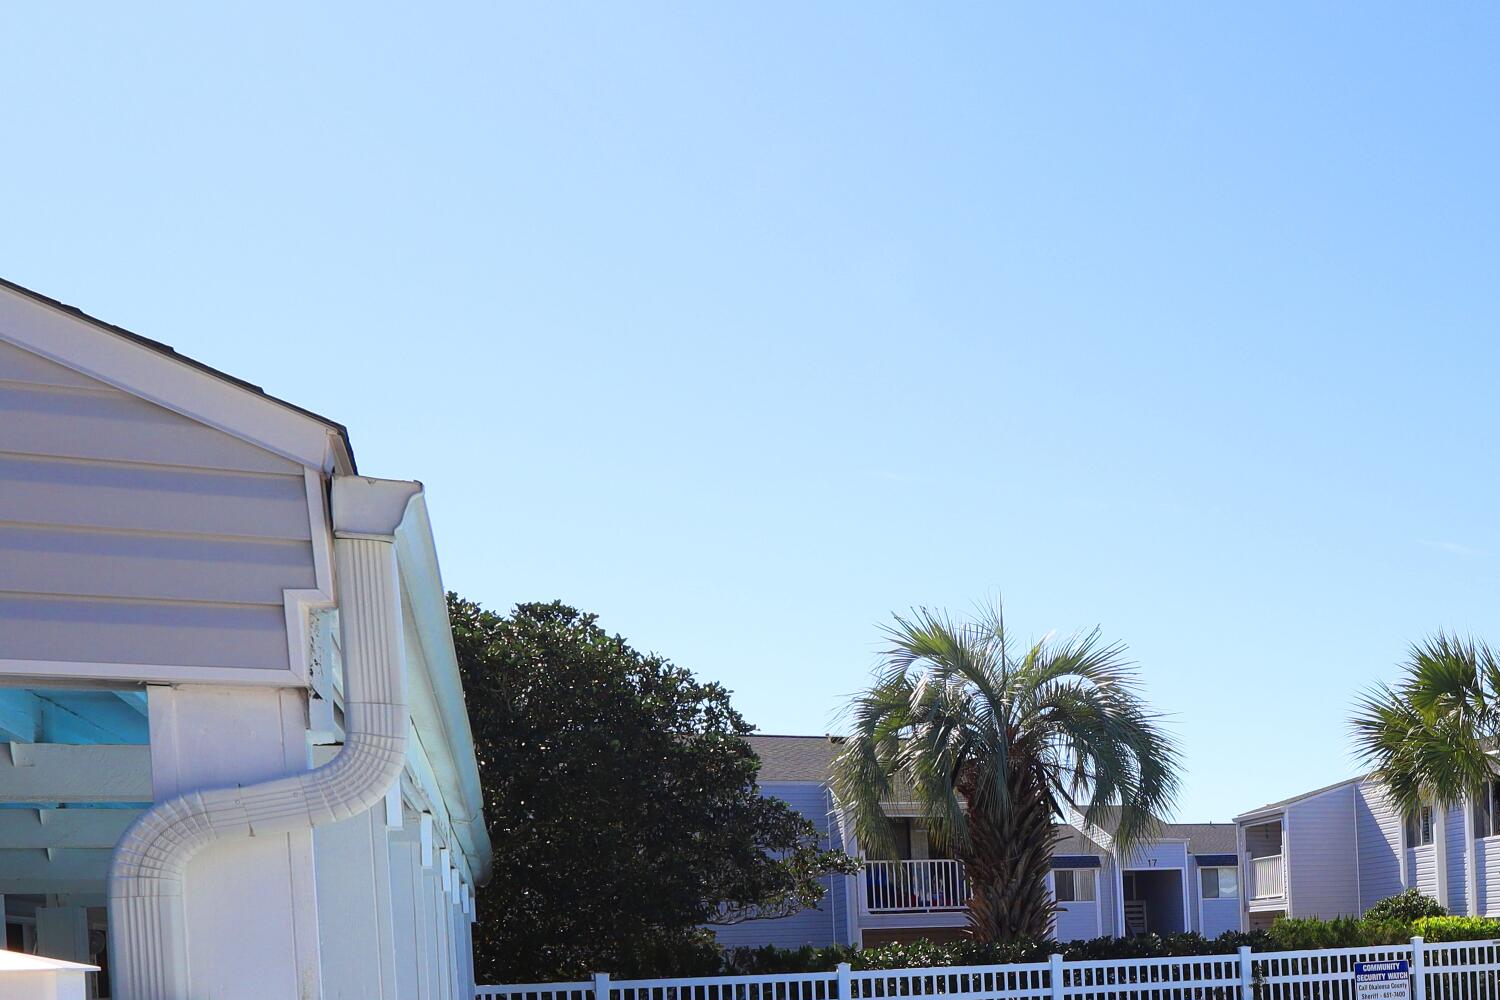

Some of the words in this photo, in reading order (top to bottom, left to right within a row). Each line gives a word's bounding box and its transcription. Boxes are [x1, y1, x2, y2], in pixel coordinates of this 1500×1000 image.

[1148, 859, 1157, 867] 17
[1362, 962, 1400, 971] COMMUNITY
[1356, 974, 1386, 982] SECURITY
[1387, 972, 1408, 980] WATCH
